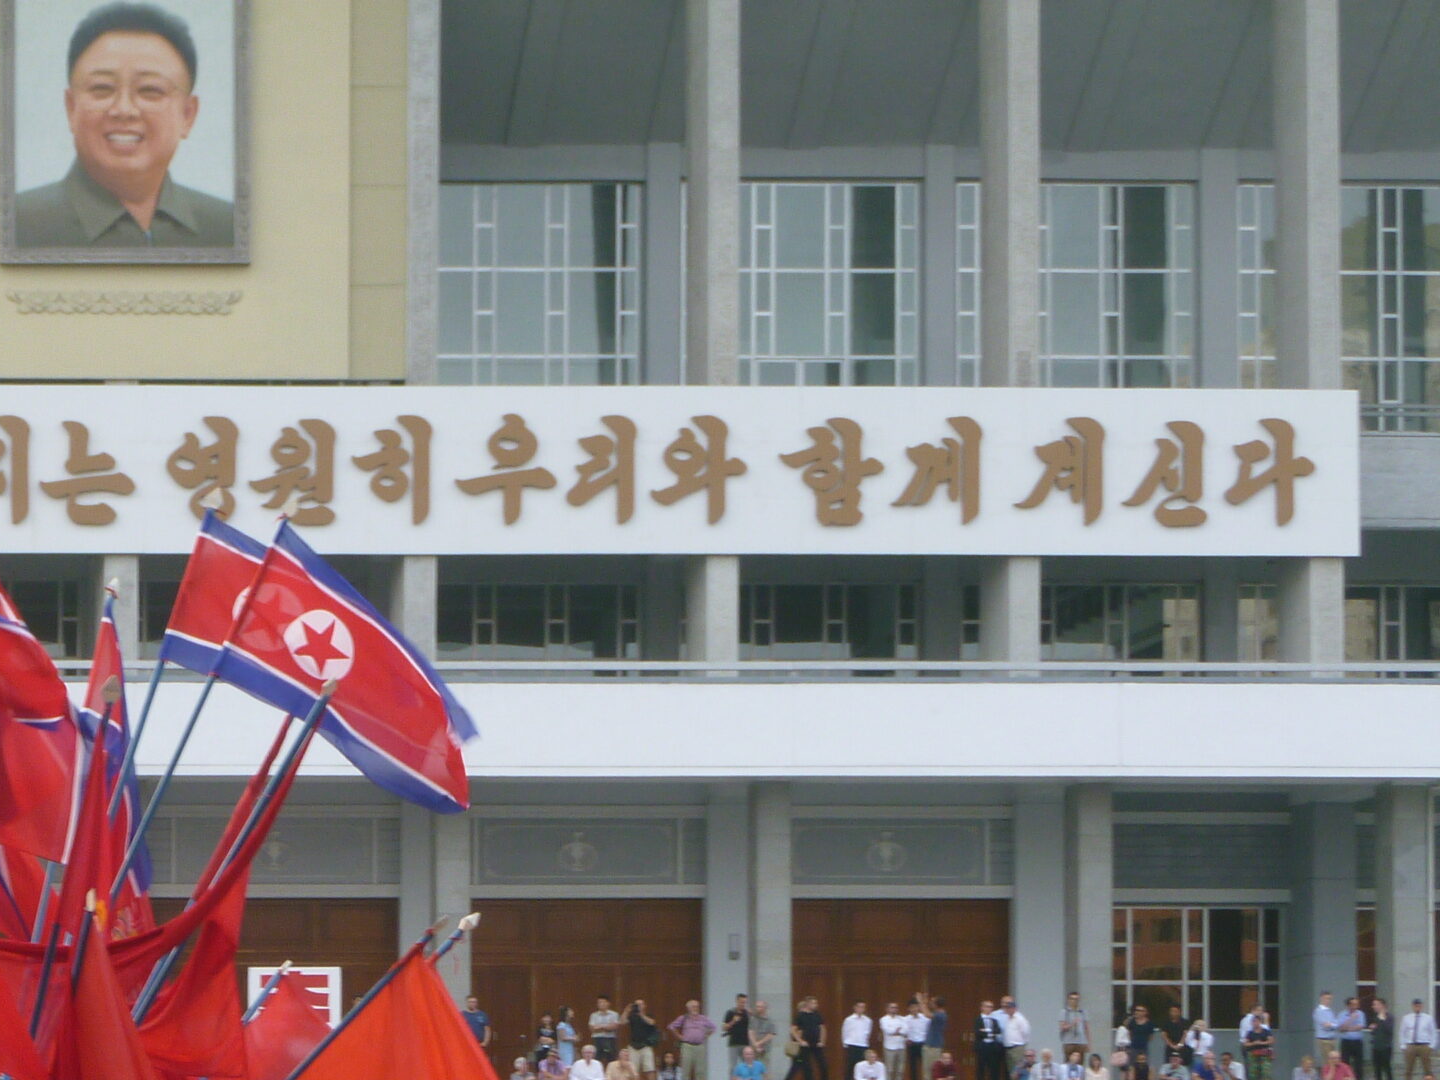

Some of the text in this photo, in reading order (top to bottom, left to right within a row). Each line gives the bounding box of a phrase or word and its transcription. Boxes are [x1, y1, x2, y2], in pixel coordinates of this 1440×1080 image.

[166, 414, 433, 526] 영원히
[455, 413, 748, 526] 우리와
[778, 416, 983, 527] 함께
[1013, 416, 1315, 527] 계신다
